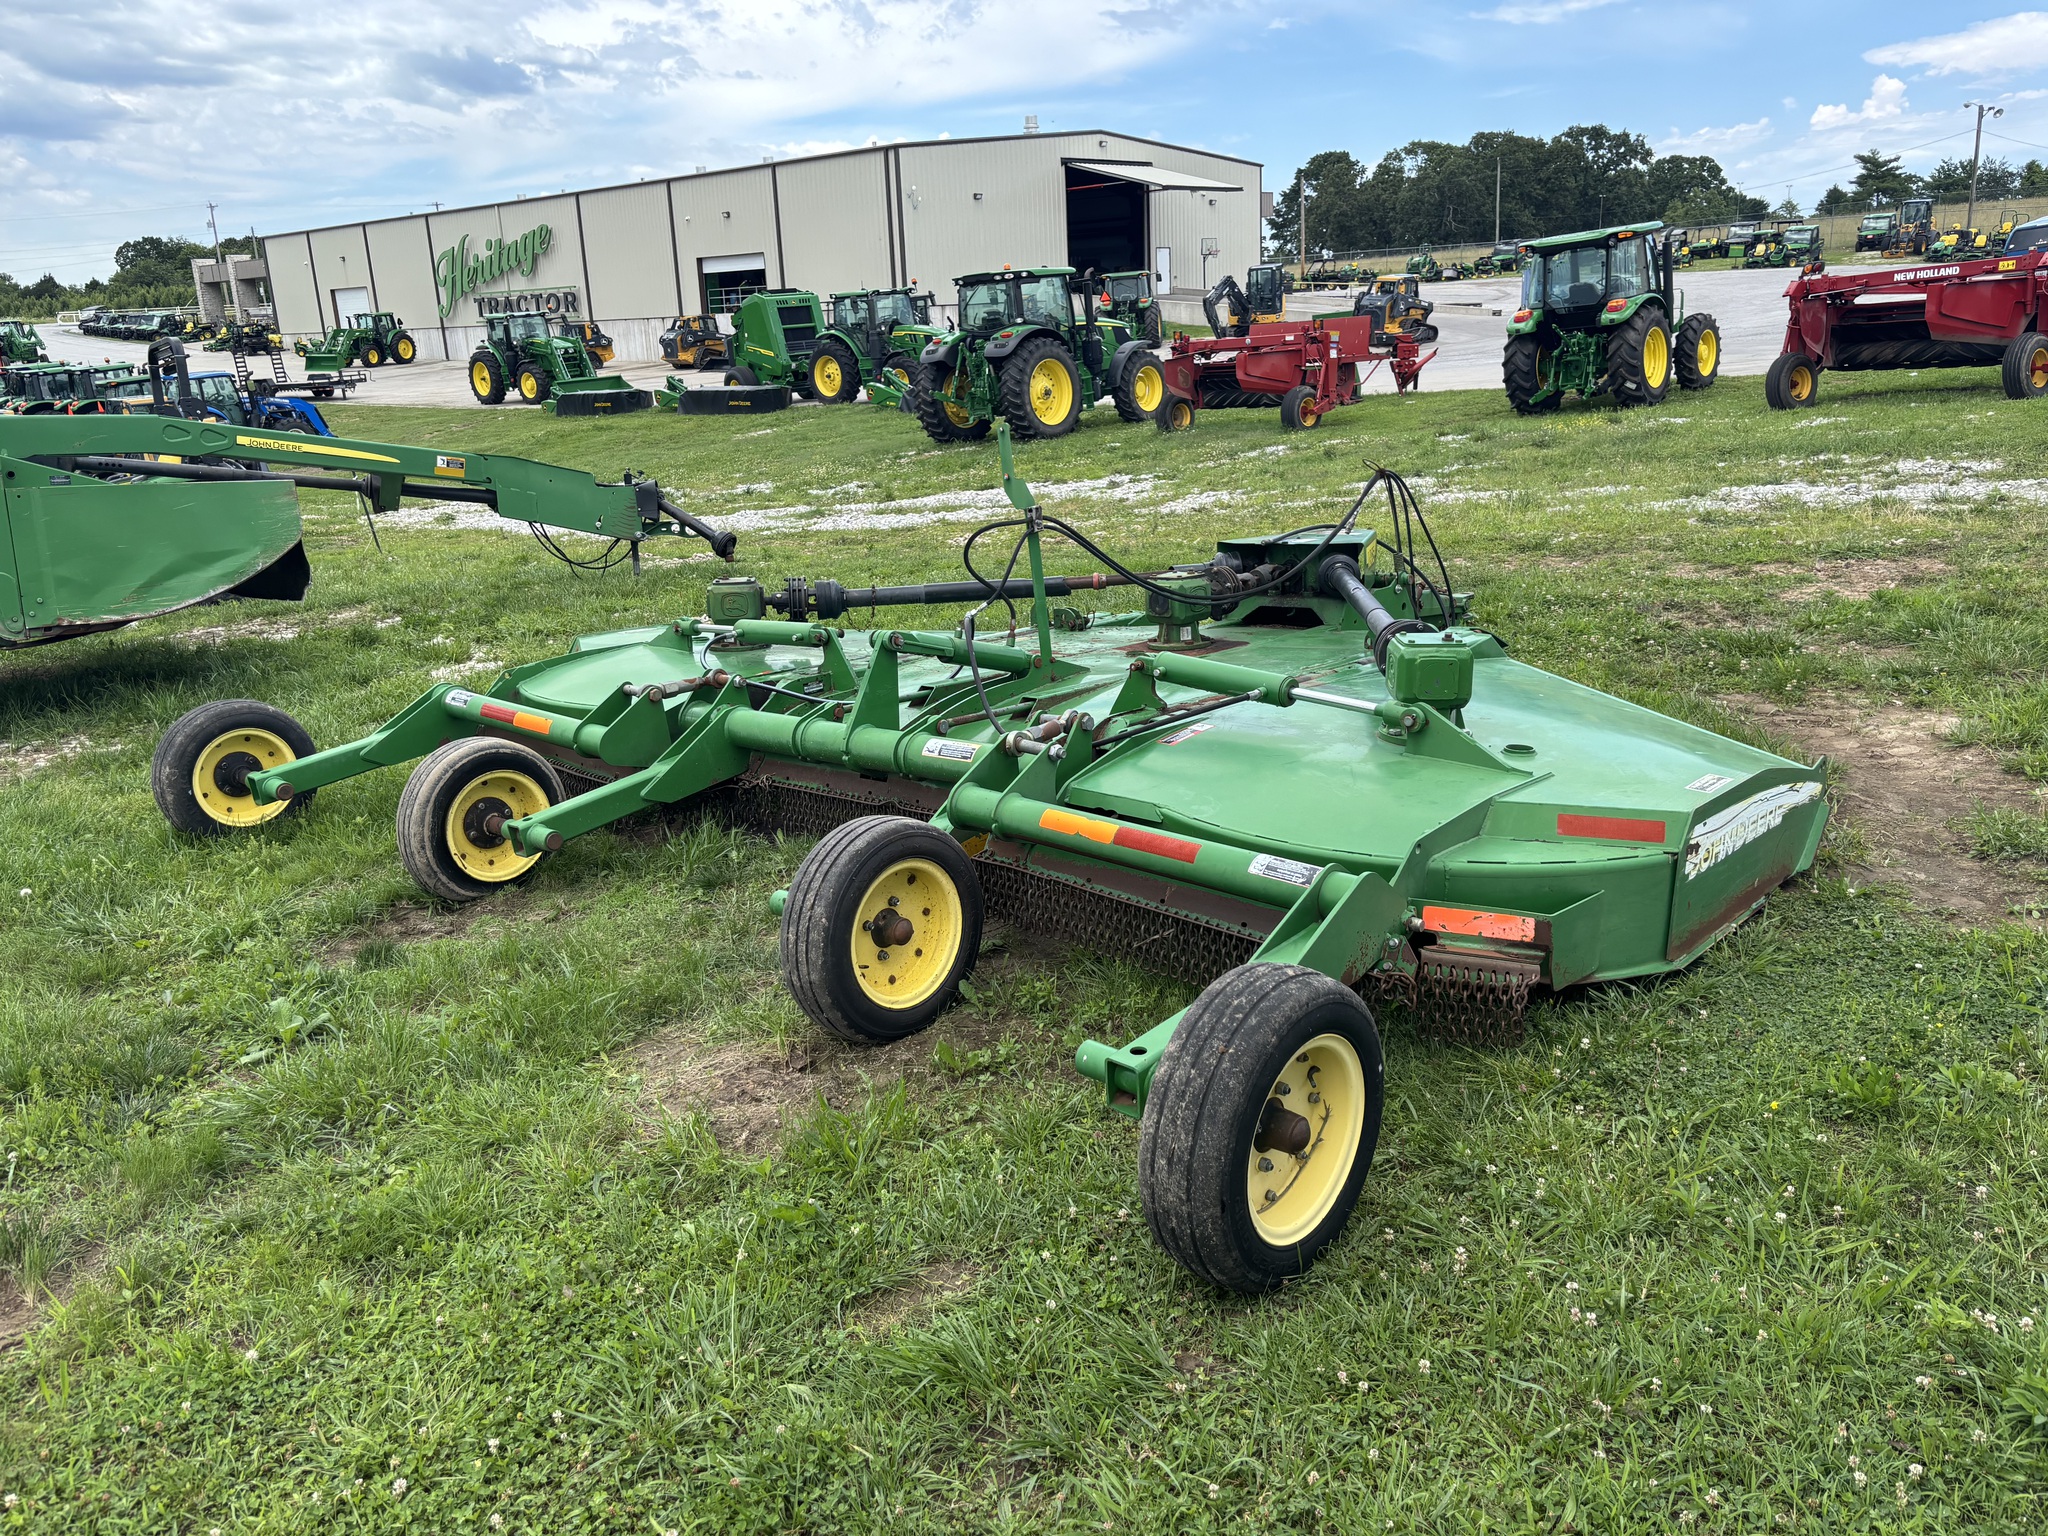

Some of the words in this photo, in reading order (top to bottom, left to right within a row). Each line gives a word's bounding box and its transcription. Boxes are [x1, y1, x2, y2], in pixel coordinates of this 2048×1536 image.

[436, 223, 551, 318] Heritage
[1893, 271, 1916, 281] NEW
[1916, 266, 1960, 279] HOLLAND
[473, 291, 578, 317] TRACTOR
[247, 438, 272, 448] JOHN
[272, 441, 303, 452] DEERE
